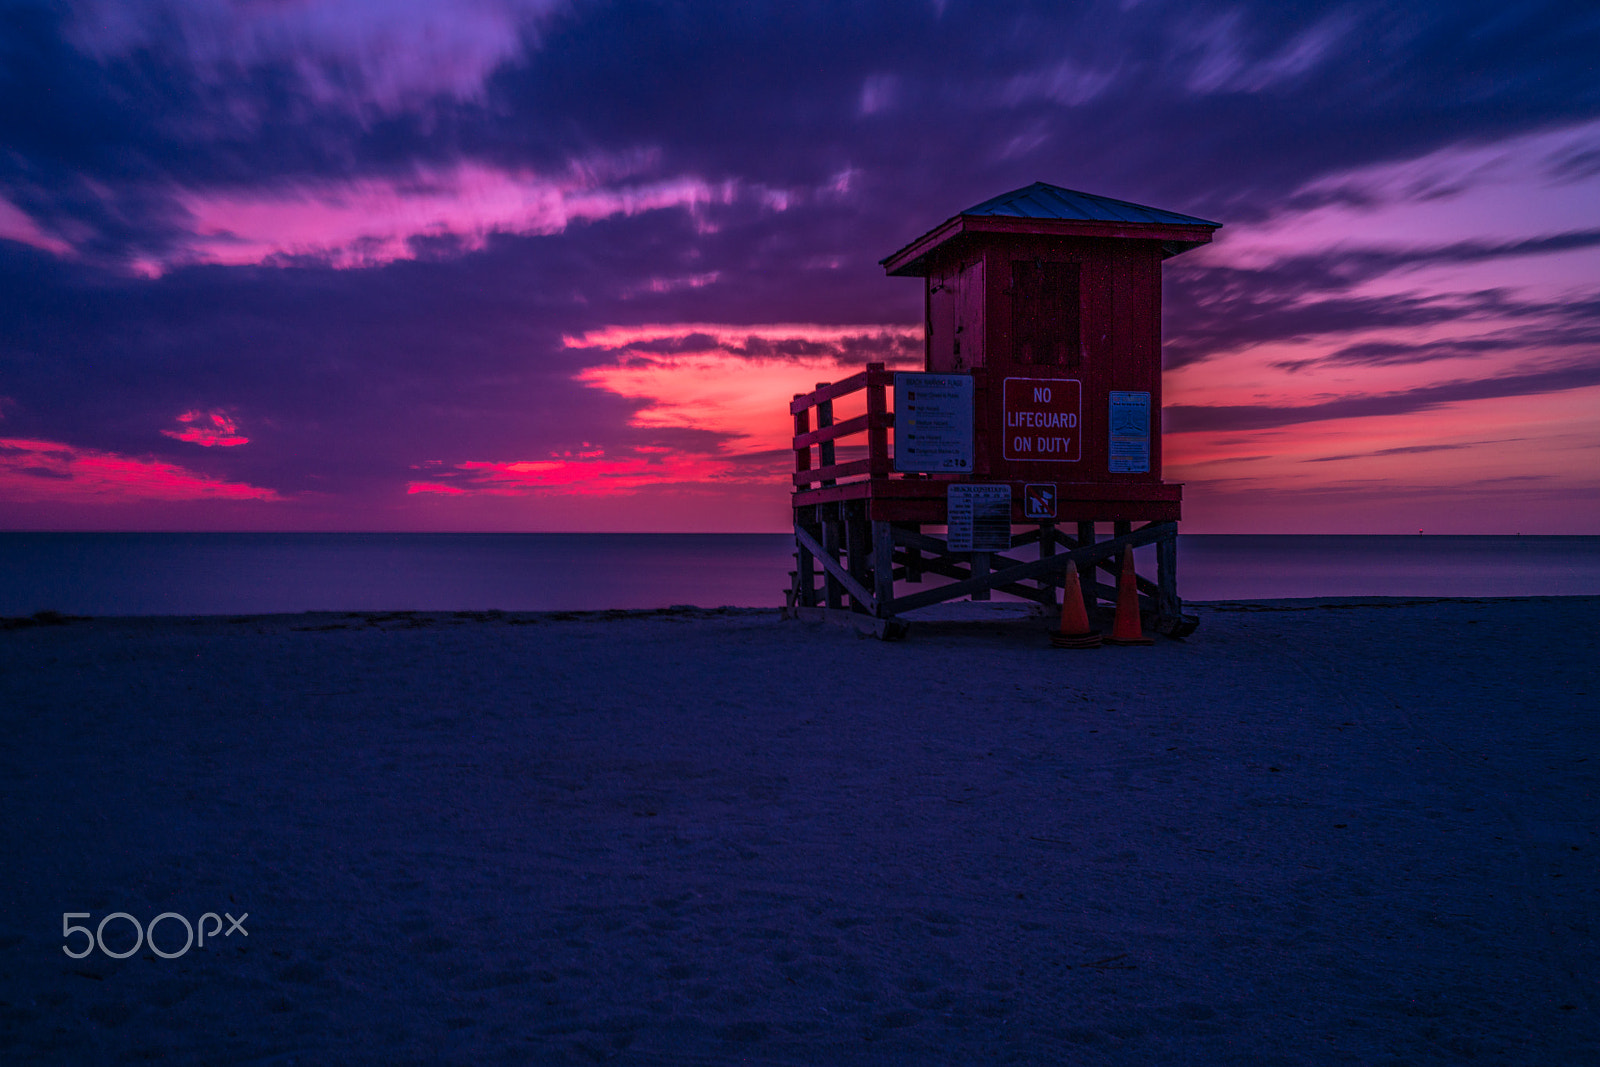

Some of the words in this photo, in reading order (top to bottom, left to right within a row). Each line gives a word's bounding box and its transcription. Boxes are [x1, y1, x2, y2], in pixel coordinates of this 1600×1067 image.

[1033, 387, 1052, 403] NO
[1007, 411, 1077, 428] LIFEGUARD
[1013, 436, 1032, 452] ON
[1037, 437, 1071, 453] DUTY
